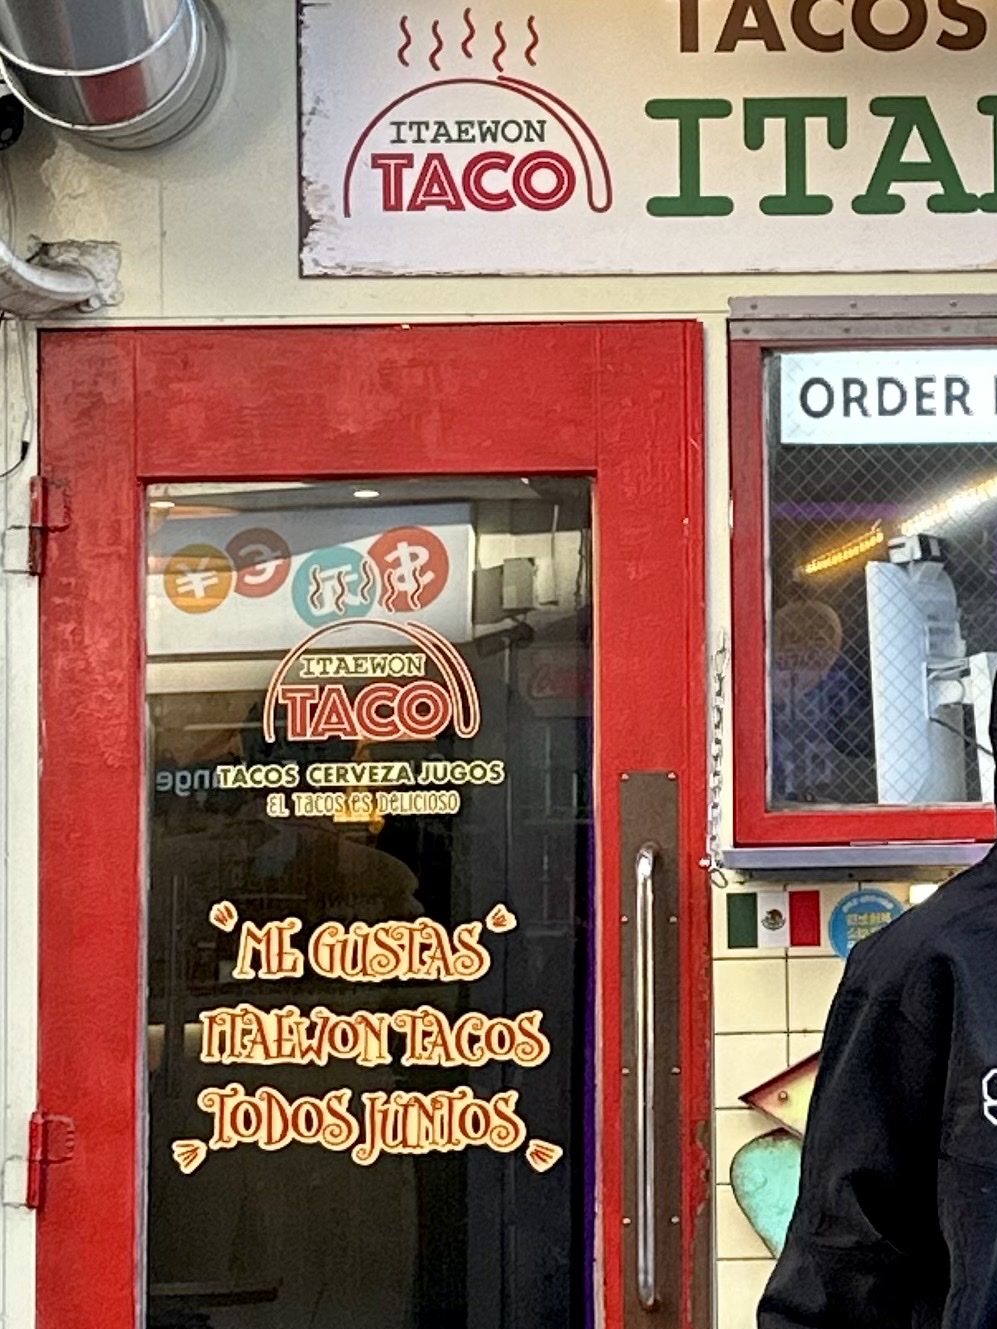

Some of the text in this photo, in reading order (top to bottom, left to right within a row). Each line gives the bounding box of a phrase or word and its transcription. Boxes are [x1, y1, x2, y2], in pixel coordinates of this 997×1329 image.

[680, 0, 987, 52] TACOS
[390, 120, 547, 144] ITAEWON
[371, 150, 576, 212] TACO
[799, 375, 974, 419] ORDER
[301, 655, 425, 677] ITAEWON
[281, 683, 451, 739] TACO
[219, 763, 503, 786] TACOS CERVEZA JUGOS
[238, 921, 487, 978] ME GUSTAS
[204, 1009, 548, 1064] ITAEWON TACOS
[201, 1086, 523, 1163] TODOS JUNTOS
